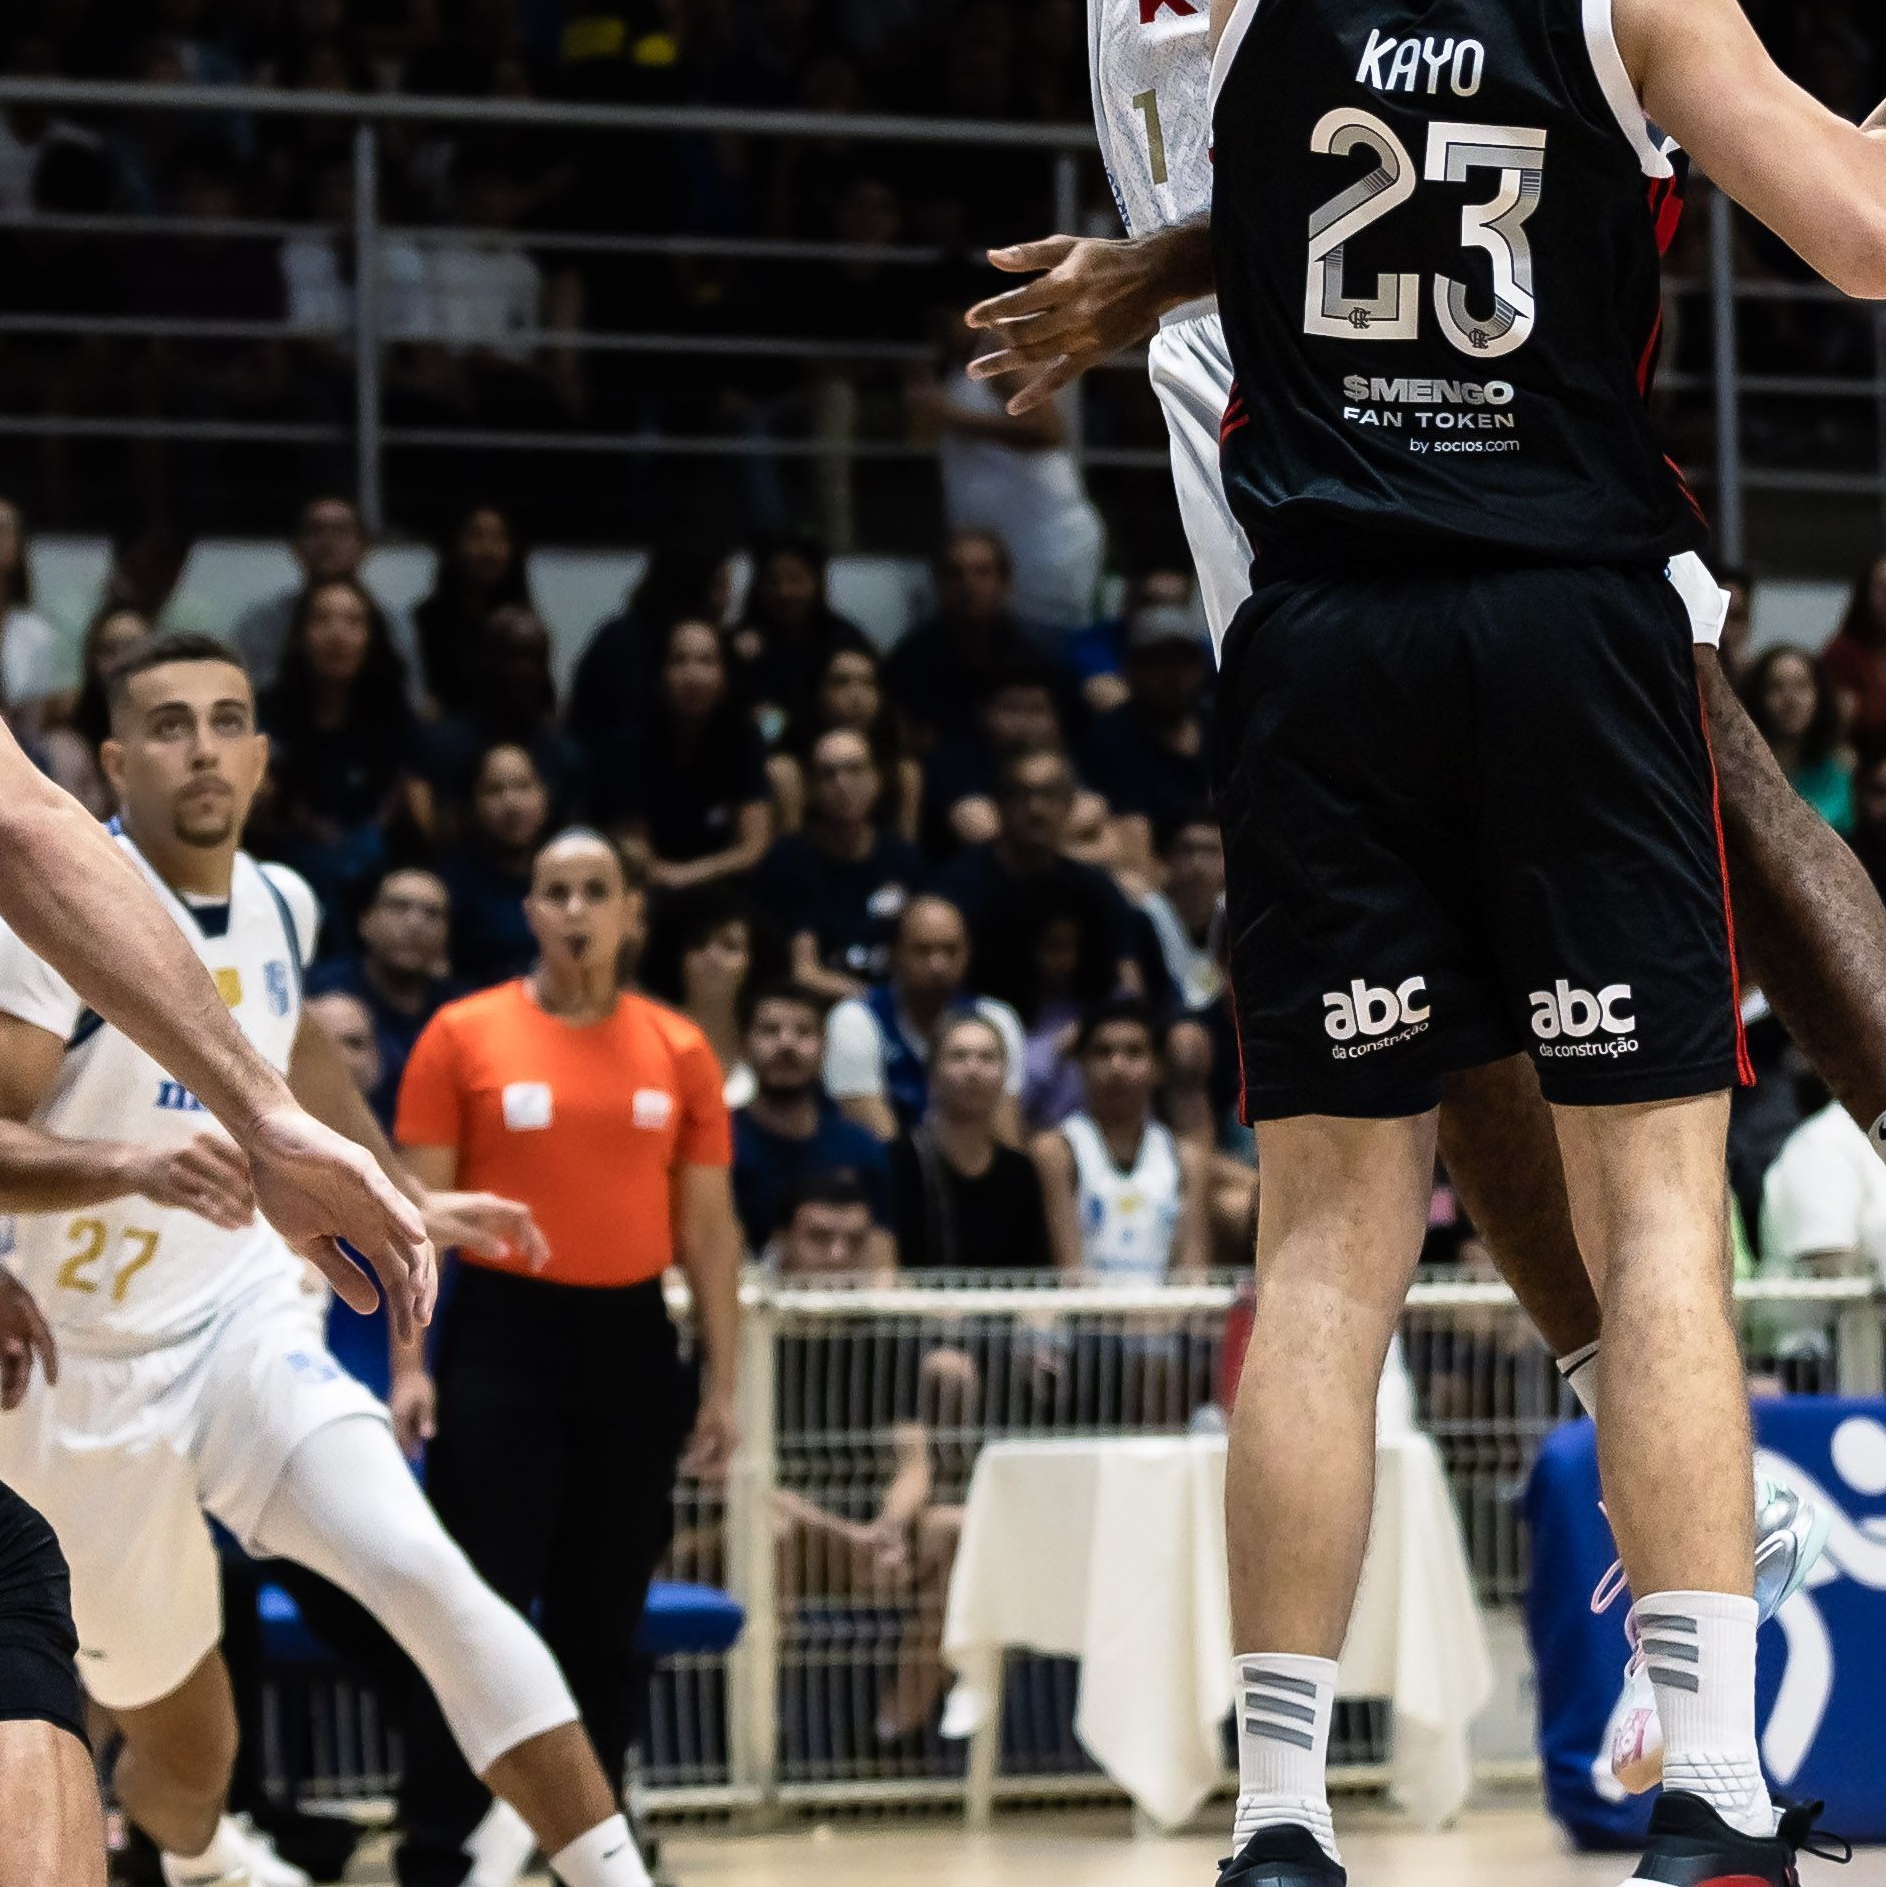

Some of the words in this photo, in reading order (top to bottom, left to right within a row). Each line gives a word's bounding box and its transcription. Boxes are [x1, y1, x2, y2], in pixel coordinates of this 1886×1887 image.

[1355, 28, 1486, 98] KAYO
[1303, 106, 1548, 359] 23
[1342, 373, 1514, 406] $MENGO
[1342, 406, 1403, 429] FAN
[1415, 412, 1515, 429] TOKEN
[1409, 437, 1429, 454] by
[1434, 438, 1521, 454] socios.com
[1322, 975, 1431, 1041] abc
[1528, 979, 1636, 1038] abc
[1539, 1043, 1553, 1057] da
[1554, 1037, 1639, 1059] construção
[57, 1216, 161, 1302] 27
